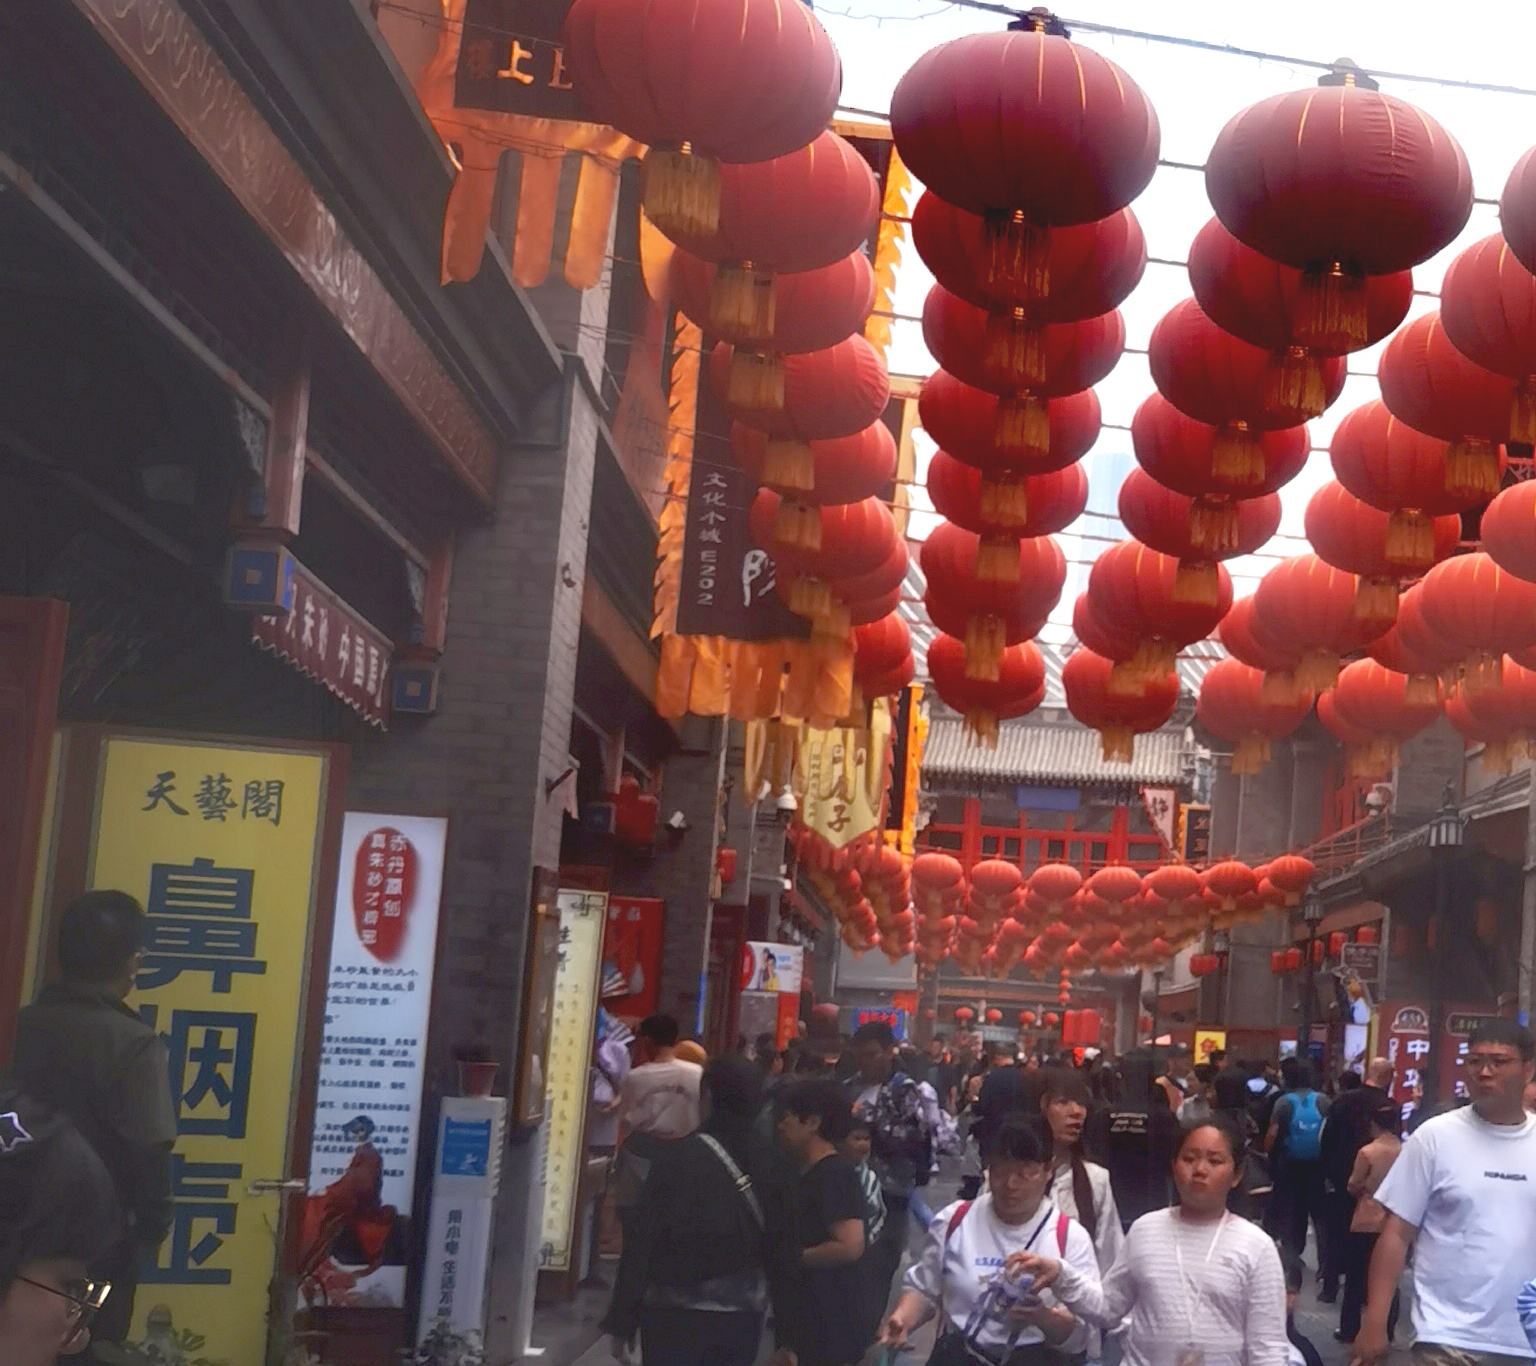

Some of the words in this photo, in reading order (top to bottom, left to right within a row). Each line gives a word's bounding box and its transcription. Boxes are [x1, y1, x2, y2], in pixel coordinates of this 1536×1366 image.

[141, 770, 286, 827] 天藝閣
[136, 857, 267, 1285] 鼻烟壶
